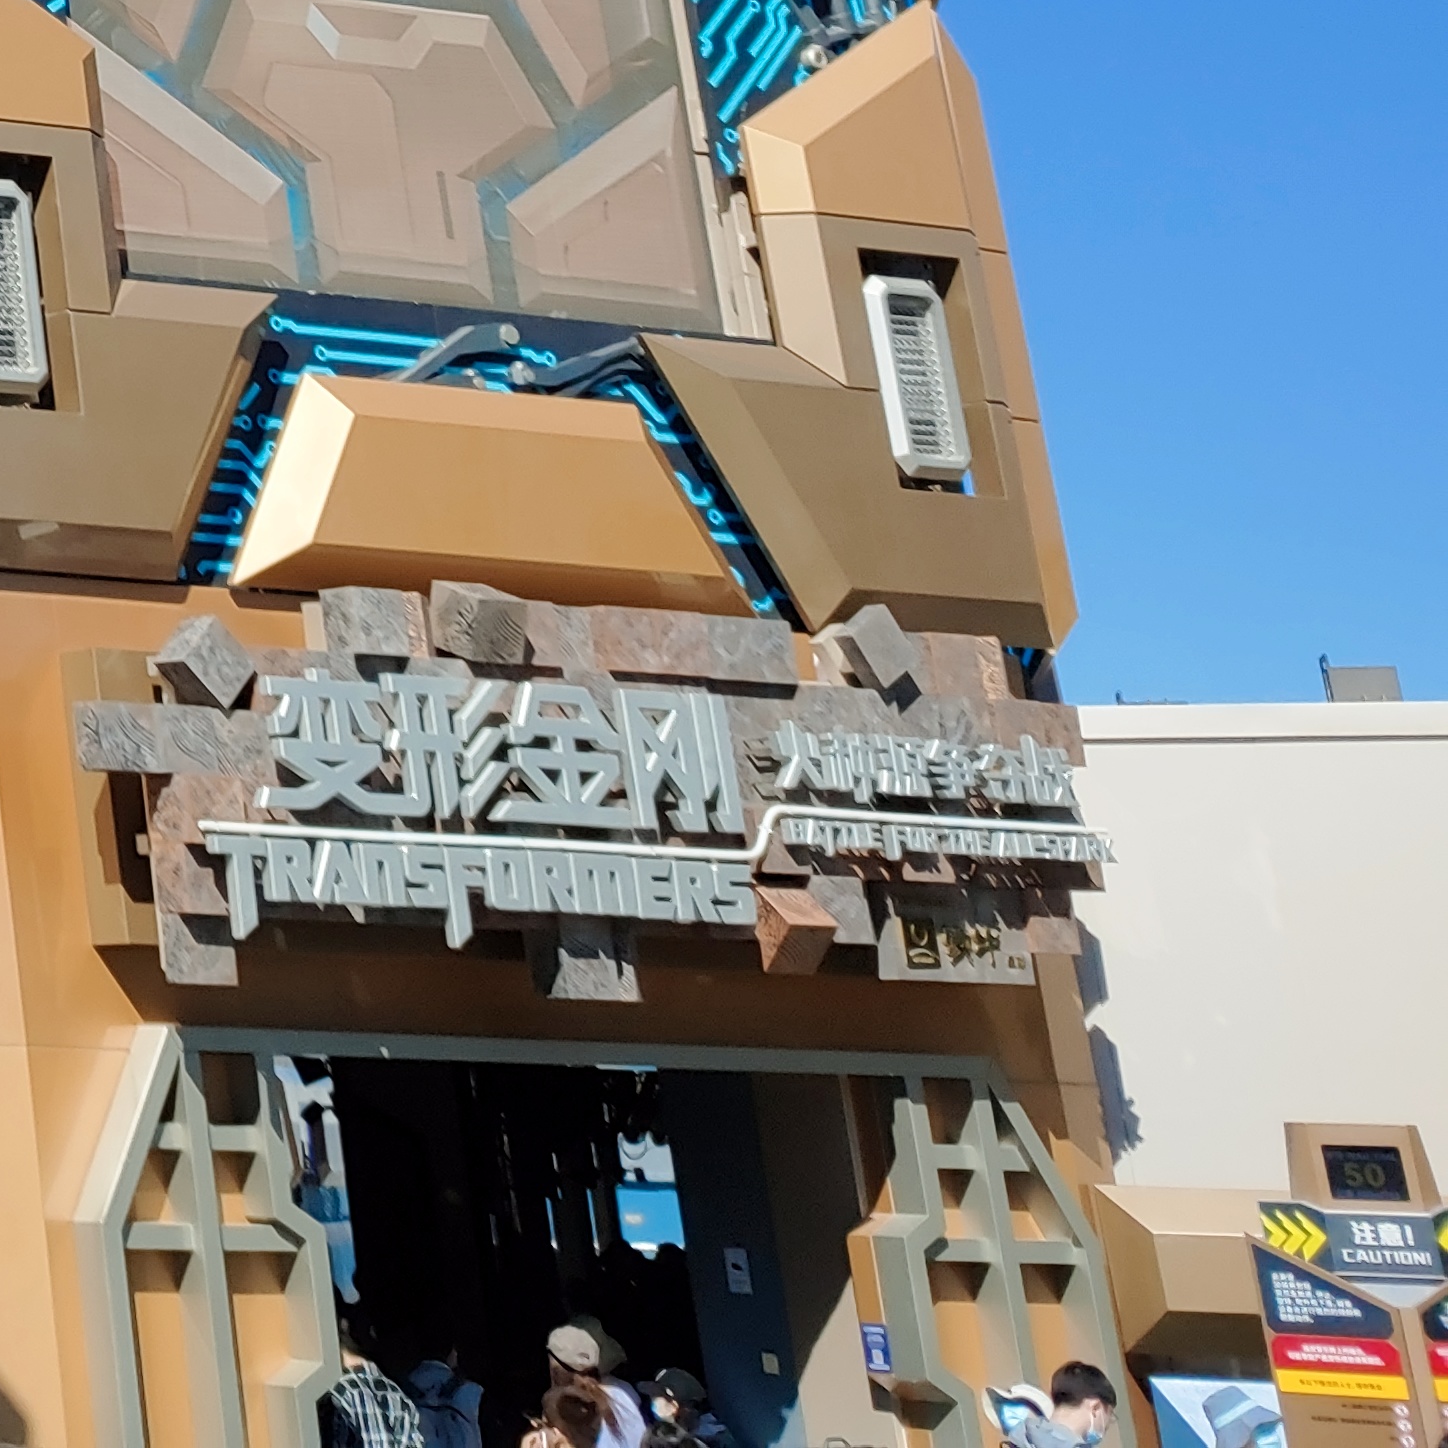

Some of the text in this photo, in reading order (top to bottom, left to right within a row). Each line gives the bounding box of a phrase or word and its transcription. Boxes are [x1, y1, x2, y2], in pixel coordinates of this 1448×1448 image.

[253, 667, 744, 834] 变形金刚
[774, 719, 1080, 808] 火种源争夺战
[780, 818, 883, 857] BATTLE
[882, 824, 942, 860] FOR
[946, 828, 992, 856] THE
[206, 836, 758, 949] TRANSFORMERS
[1343, 1162, 1386, 1188] 50
[1341, 1248, 1432, 1267] CAUTION!
